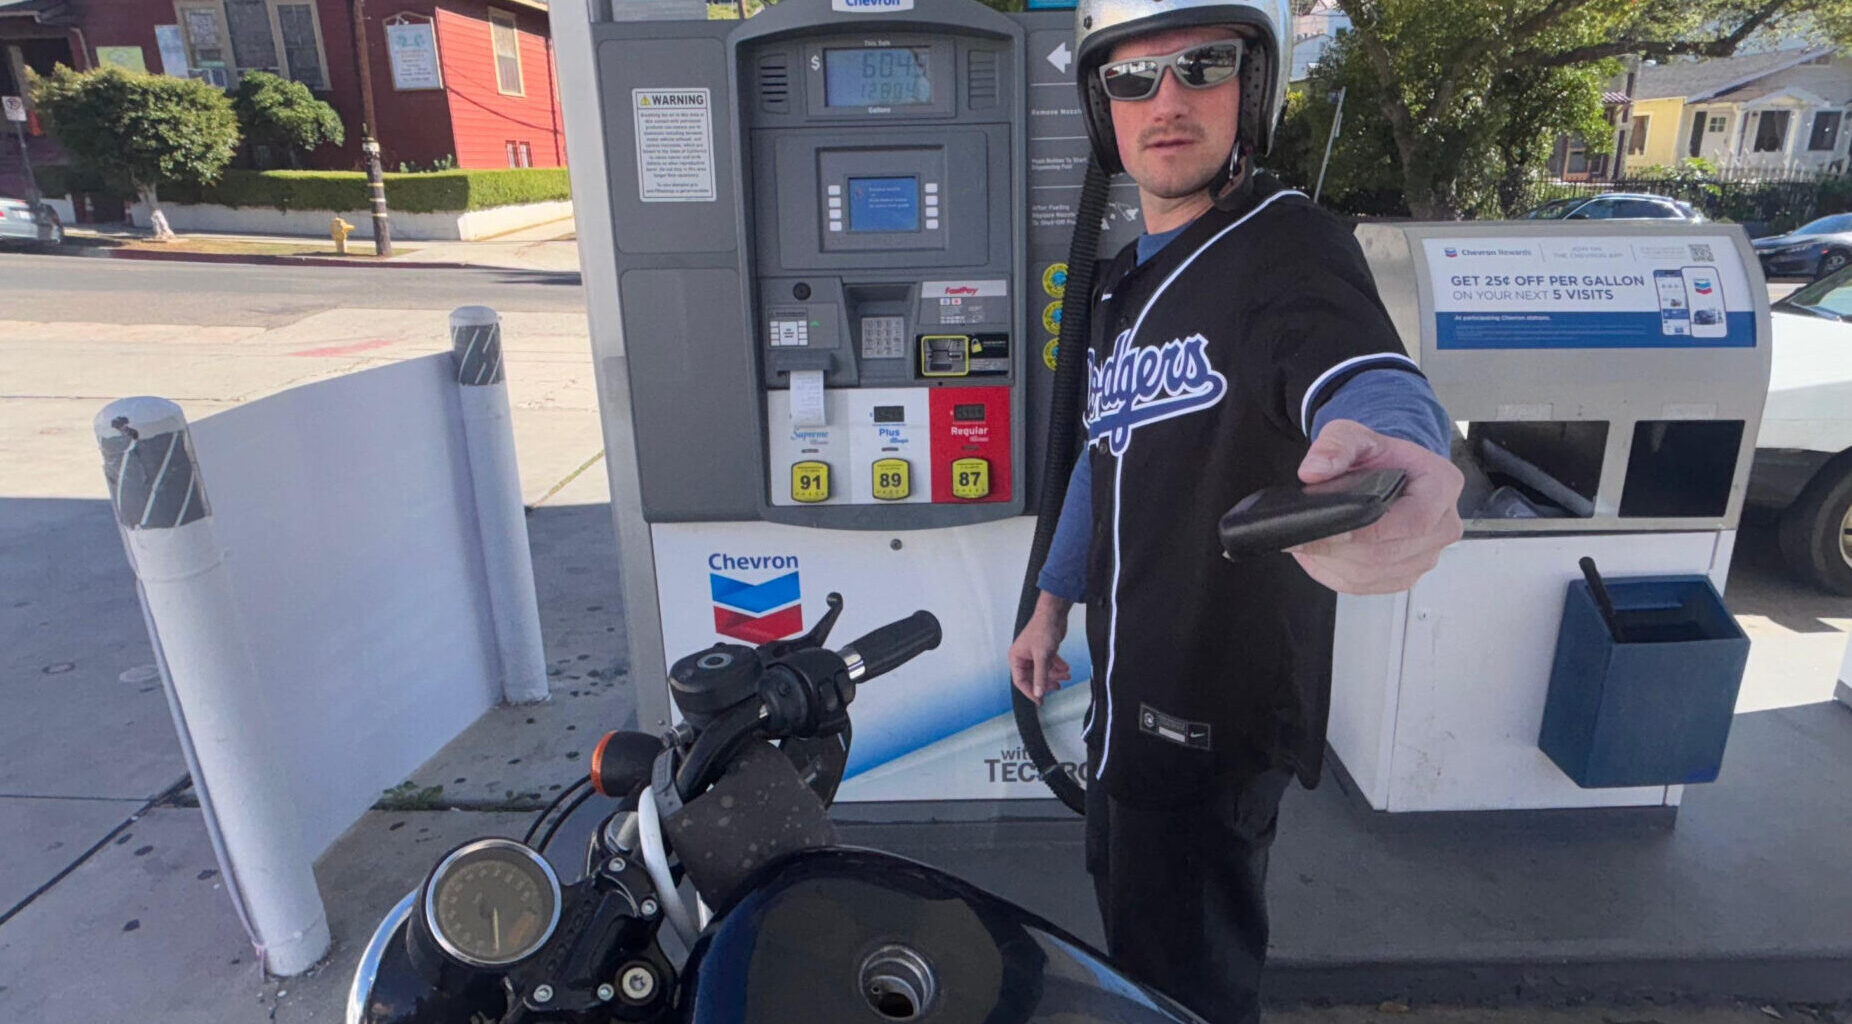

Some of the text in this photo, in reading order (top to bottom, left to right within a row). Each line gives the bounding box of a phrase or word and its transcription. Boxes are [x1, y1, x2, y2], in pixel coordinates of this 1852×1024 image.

[811, 55, 820, 71] $
[651, 95, 705, 106] WARNING
[1461, 248, 1497, 256] Chevron
[1450, 275, 1645, 287] GET 25¢ OFF PER GALLON
[1452, 289, 1614, 301] ON YOUR NEXT 5 VISITS
[878, 428, 900, 437] Plus
[950, 426, 989, 438] Regular
[799, 474, 821, 490] 91
[879, 472, 902, 488] 89
[958, 471, 982, 487] 87
[708, 553, 799, 570] Chevron
[1001, 747, 1029, 760] wit
